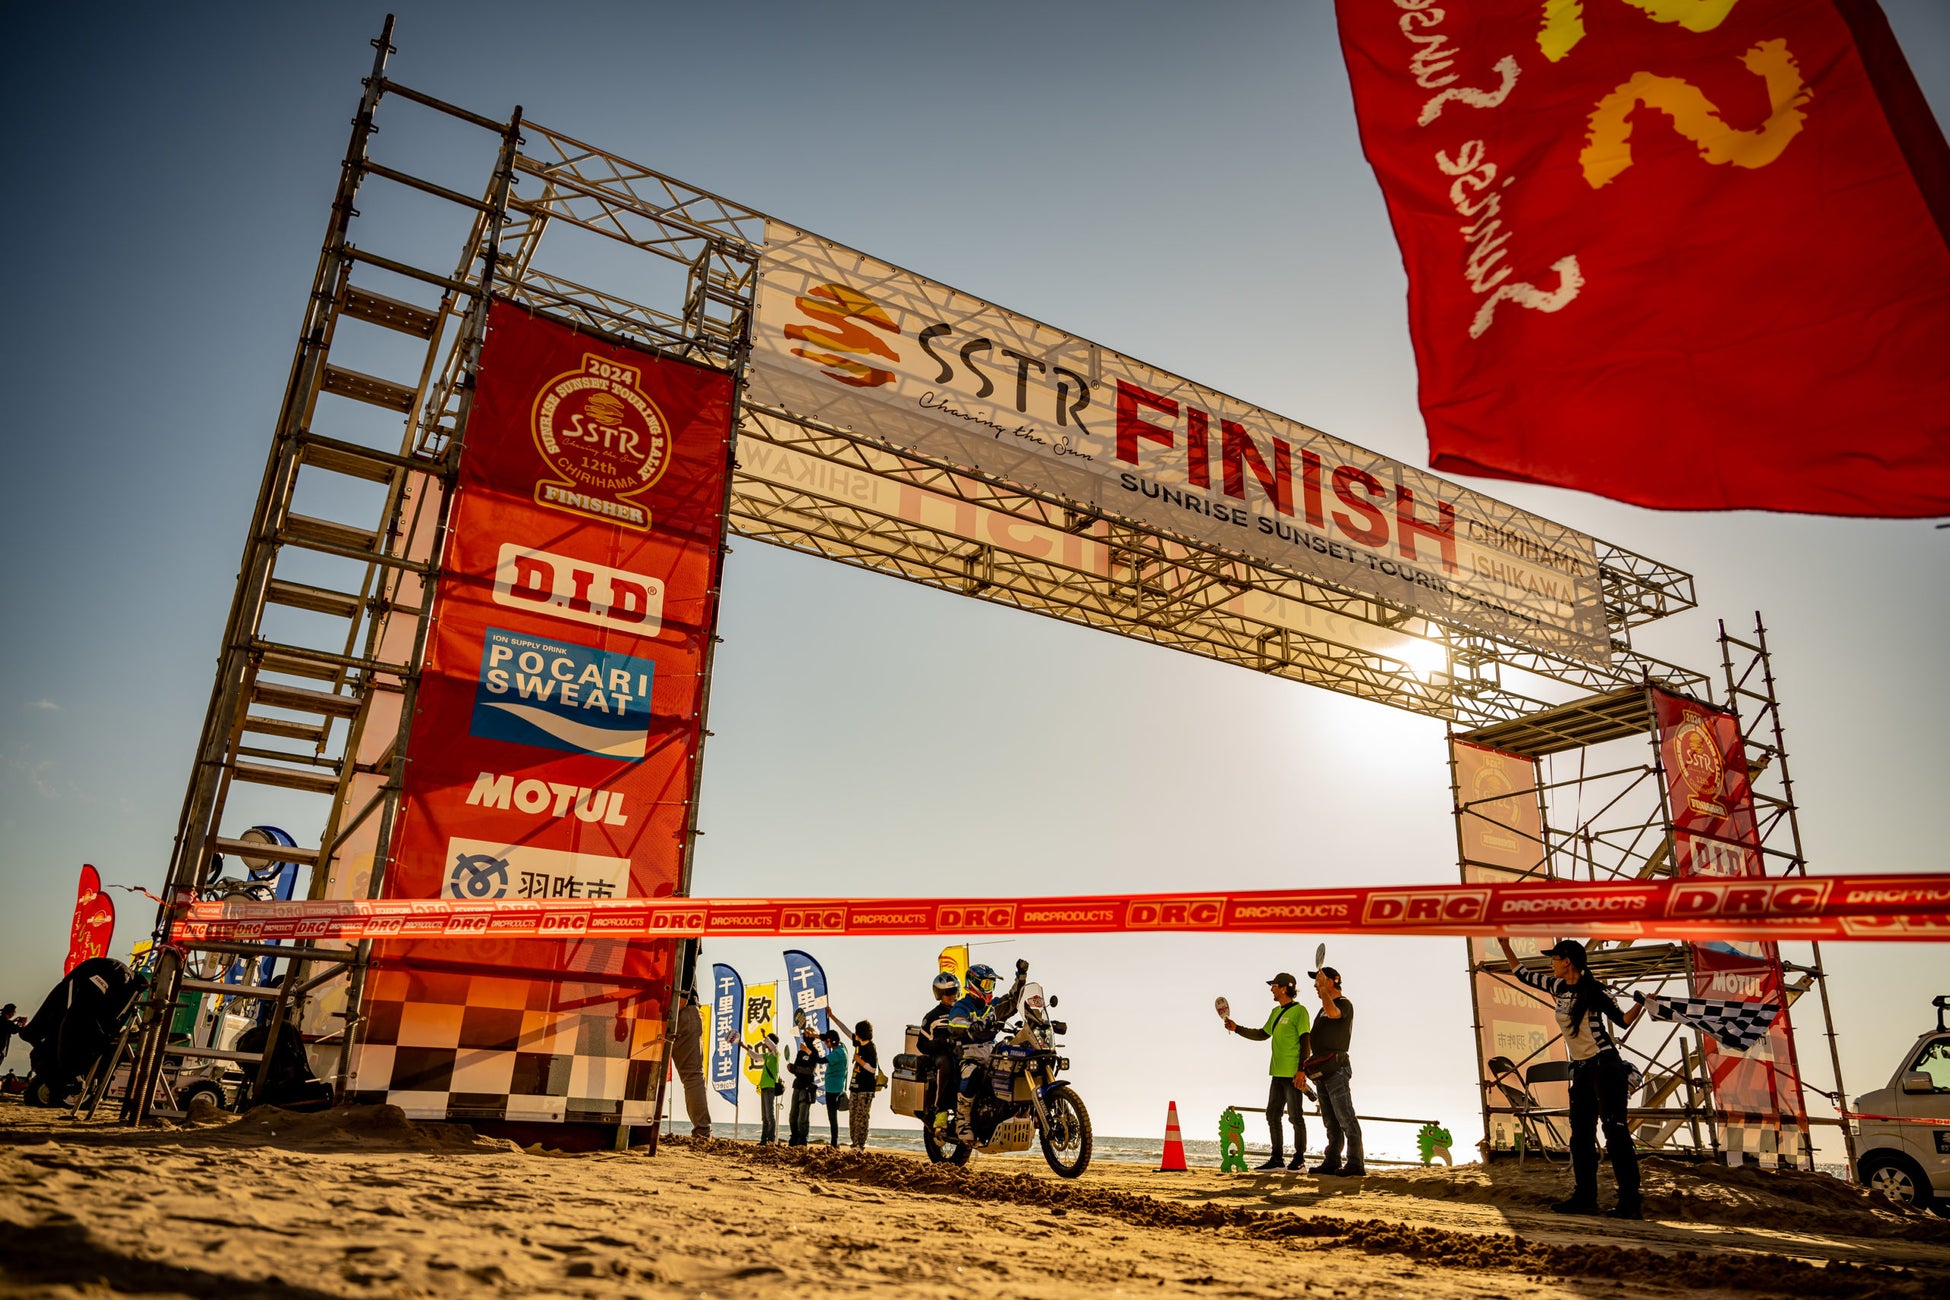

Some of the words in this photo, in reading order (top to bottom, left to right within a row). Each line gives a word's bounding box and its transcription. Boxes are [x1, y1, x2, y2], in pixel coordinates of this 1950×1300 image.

[588, 359, 633, 385] 2024
[540, 393, 561, 455] SUNRISE
[555, 377, 610, 398] SUNSET
[611, 383, 662, 435] TOURING
[637, 436, 664, 481] RALLY
[562, 414, 645, 459] SSTR
[918, 391, 1006, 439] Chasing
[1013, 425, 1047, 445] the
[1053, 435, 1095, 462] Sun
[558, 457, 638, 489] CHIRIHAMA
[581, 456, 618, 476] 12th
[1116, 378, 1460, 577] FINISH
[544, 485, 644, 523] FINISHER
[1120, 472, 1249, 528] SUNRISE
[1258, 516, 1358, 564] SUNSET
[1364, 552, 1472, 601] TOURING
[1468, 518, 1583, 578] CHIRIHAMA
[1471, 552, 1575, 608] ISHIKAWA
[492, 634, 509, 643] ION
[511, 637, 541, 650] SUPPLY
[542, 643, 568, 655] DRINK
[485, 669, 634, 716] SWEAT
[488, 644, 649, 698] POCARI
[465, 771, 629, 827] MOTUL
[184, 924, 206, 934] DRC
[236, 922, 261, 934] DRC
[297, 921, 326, 933] DRC
[368, 919, 401, 931] DRC
[449, 917, 487, 931] DRC
[491, 919, 536, 928] DRCPRODUCTS
[543, 915, 586, 929] DRC
[592, 917, 644, 927] DRCPRODUCTS
[652, 914, 704, 929] DRC
[711, 916, 773, 926] DRCPRODUCTS
[783, 911, 843, 928] DRC
[853, 913, 926, 924] DRCPRODUCTS
[939, 908, 1014, 927] DRC
[1023, 910, 1113, 922] DRCPRODUCTS
[1128, 902, 1219, 924] DRC
[1235, 904, 1348, 919] DRCPRODUCTS
[1368, 896, 1483, 921] DRC
[1502, 896, 1647, 913] DRCPRODUCTS
[1671, 887, 1821, 915] DRC
[1711, 970, 1763, 998] MOTUL
